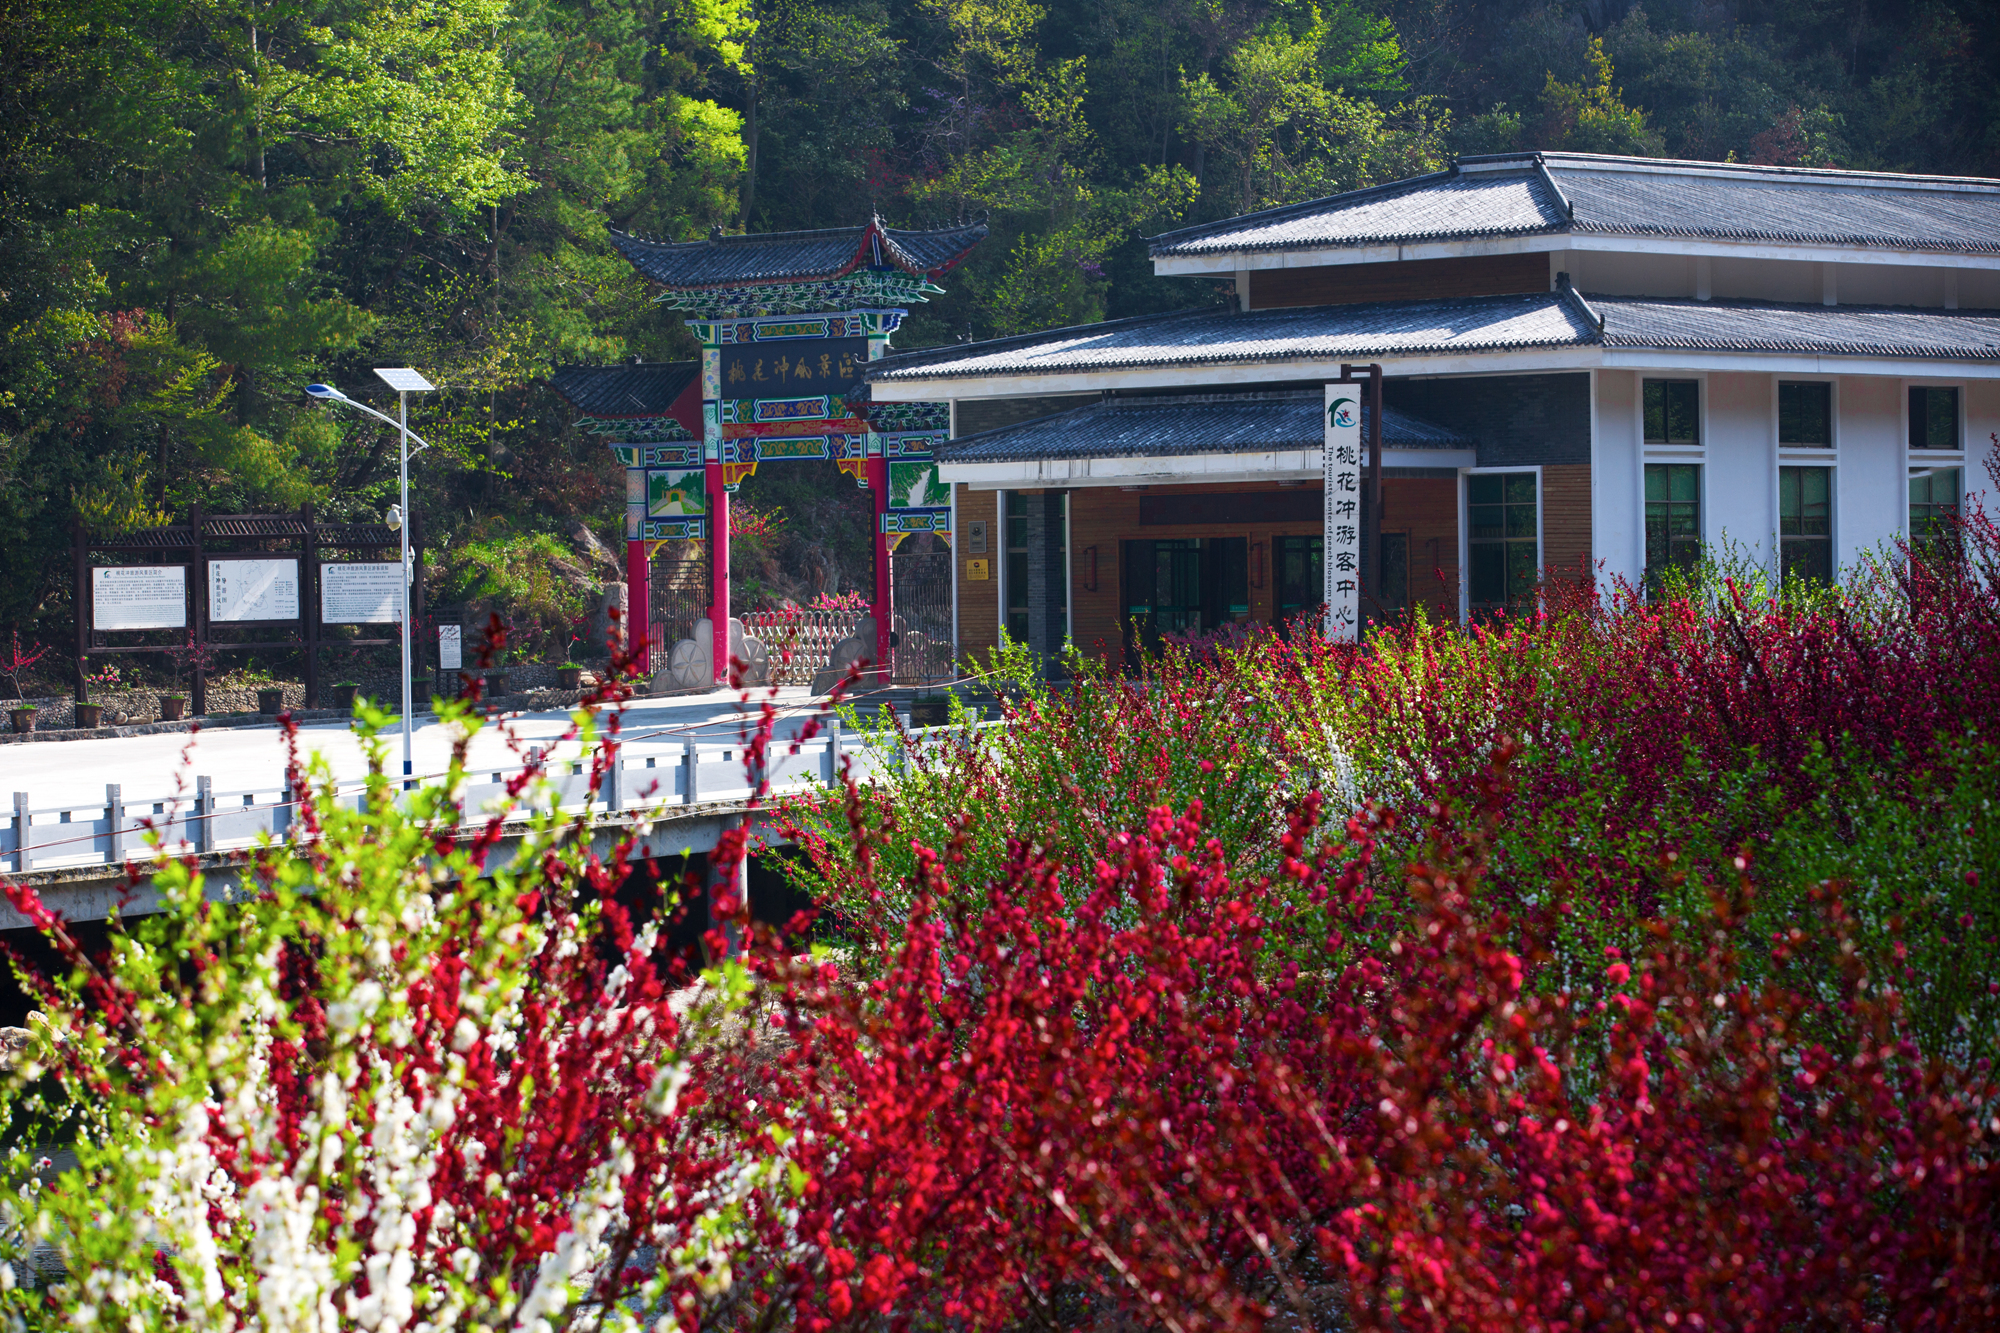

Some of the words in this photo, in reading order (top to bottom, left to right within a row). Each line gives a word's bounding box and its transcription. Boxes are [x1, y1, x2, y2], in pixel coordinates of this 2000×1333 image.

[1328, 526, 1334, 534] of
[1335, 445, 1357, 625] 桃花冲游客中心
